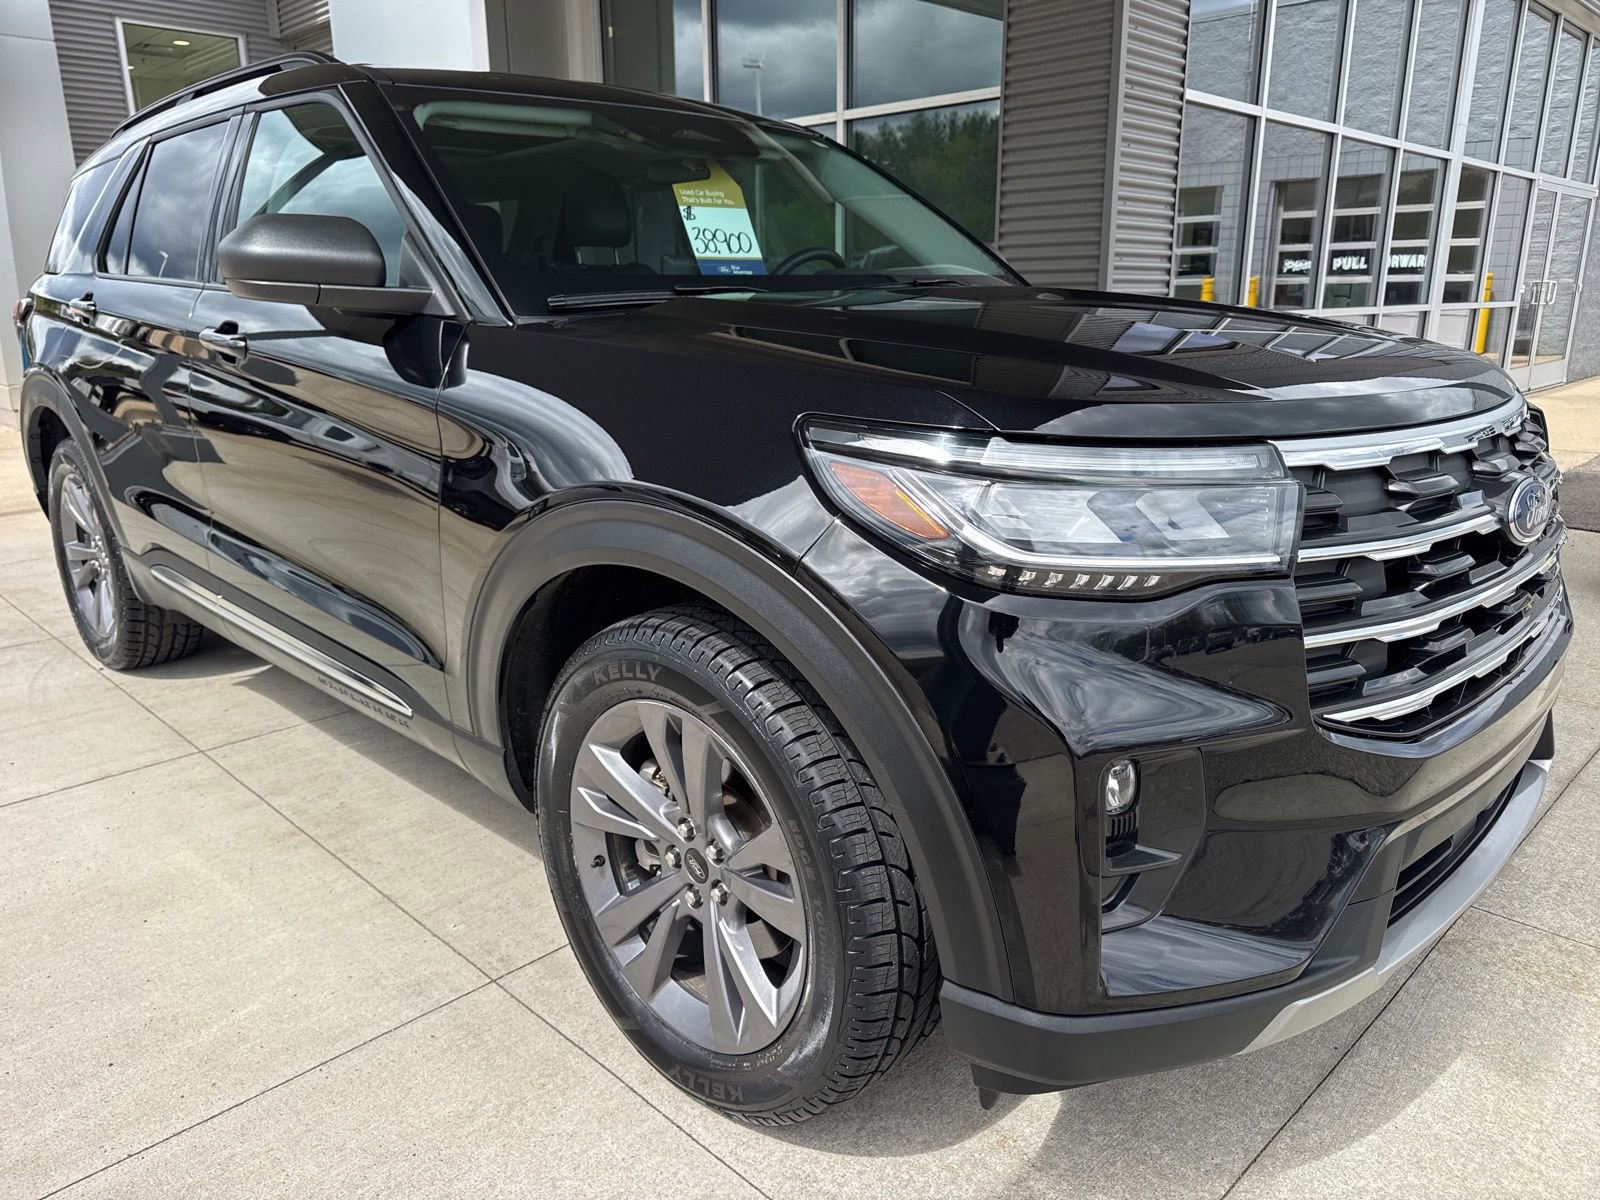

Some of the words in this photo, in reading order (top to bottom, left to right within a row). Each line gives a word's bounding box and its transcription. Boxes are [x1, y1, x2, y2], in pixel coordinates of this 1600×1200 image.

[1332, 255, 1368, 270] PULL
[592, 660, 662, 687] KELLY
[667, 1063, 744, 1103] KELLY
